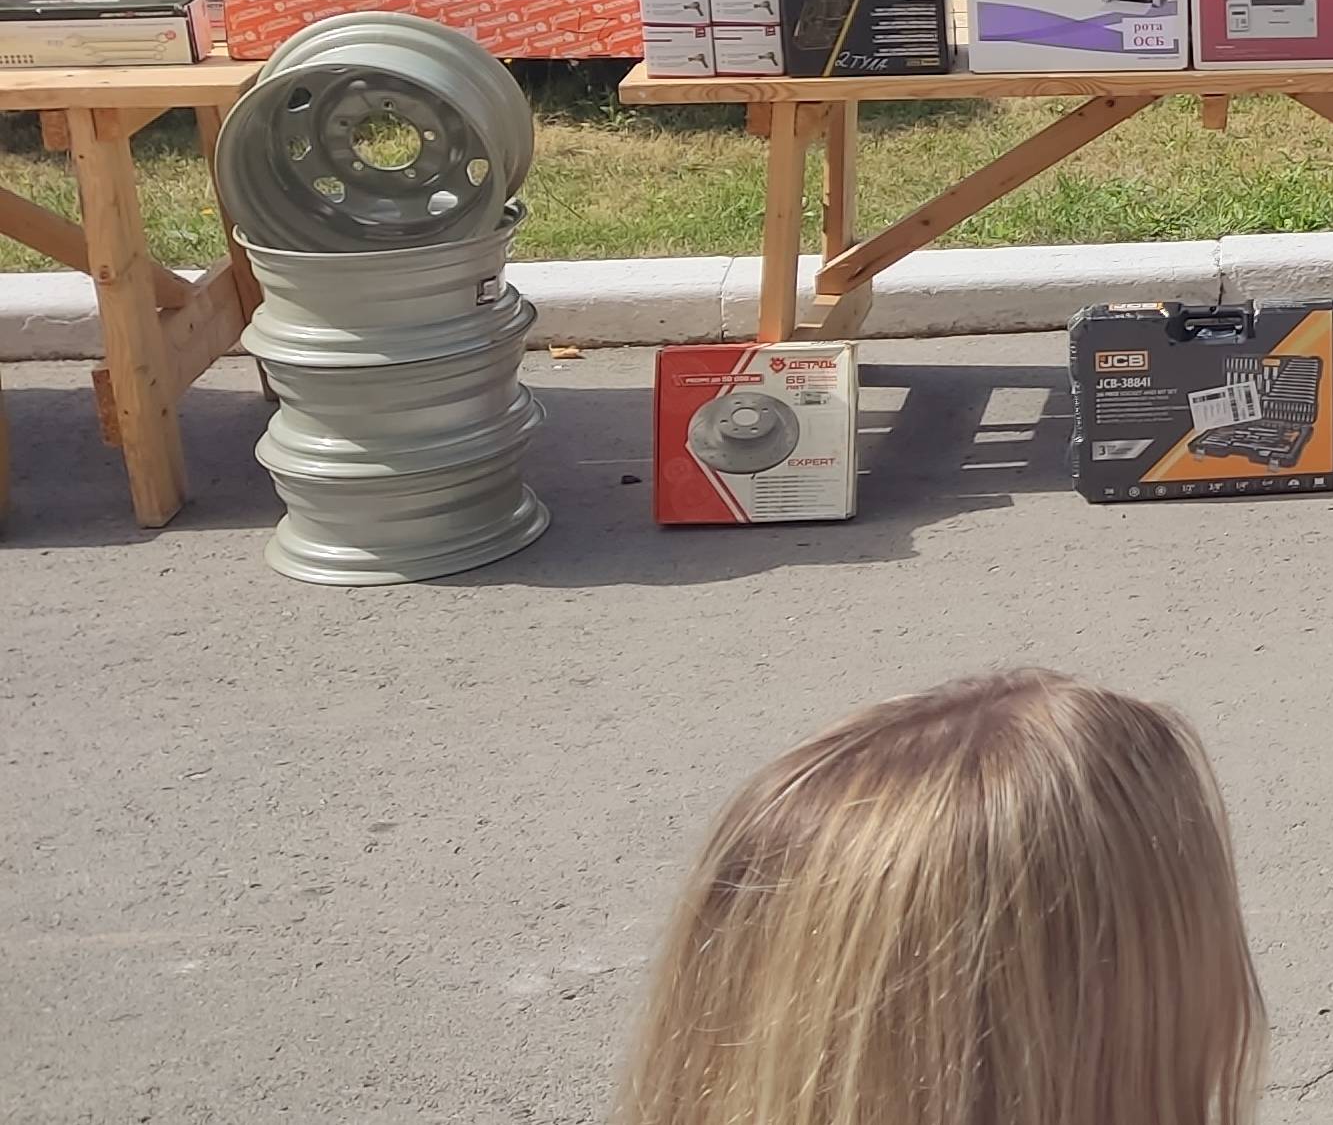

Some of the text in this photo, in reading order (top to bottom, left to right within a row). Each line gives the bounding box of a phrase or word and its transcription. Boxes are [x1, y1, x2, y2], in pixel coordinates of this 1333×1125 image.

[1133, 22, 1163, 33] рота
[1133, 35, 1165, 47] ОСБ
[788, 360, 837, 370] ДЕТАЛЬ
[1099, 354, 1145, 368] JCB
[785, 375, 806, 385] 65
[1095, 377, 1152, 390] JCB-38841
[787, 457, 837, 467] EXPERT
